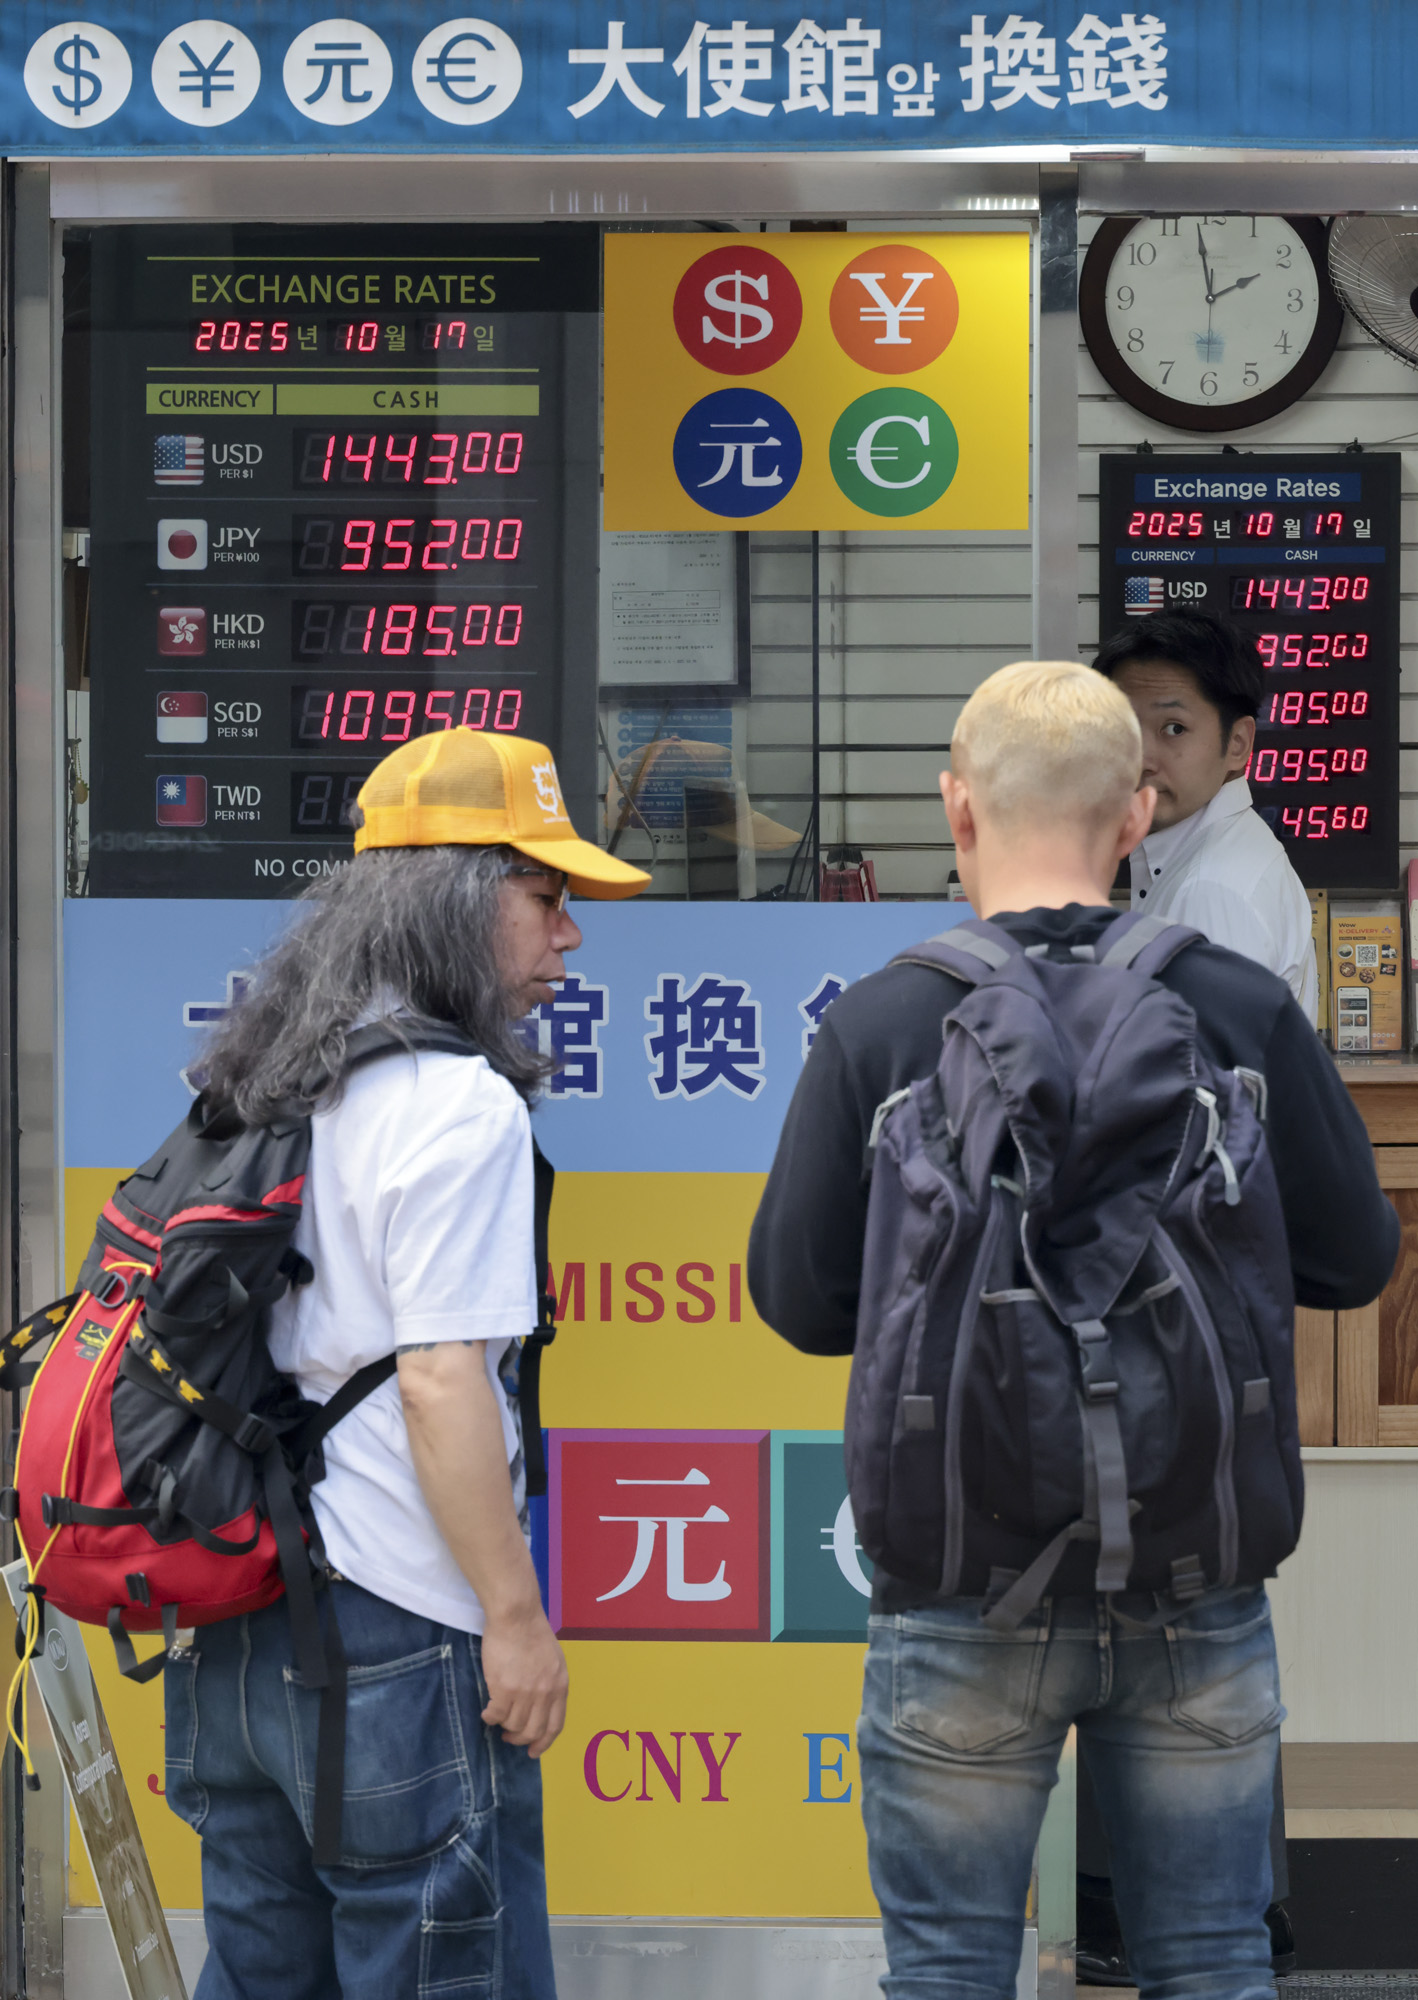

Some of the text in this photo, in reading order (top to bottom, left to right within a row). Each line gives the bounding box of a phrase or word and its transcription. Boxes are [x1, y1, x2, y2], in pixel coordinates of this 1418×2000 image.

[51, 34, 103, 116] $
[303, 42, 373, 105] 元
[958, 14, 1169, 112] 換錢
[1127, 242, 1157, 266] 10
[1276, 244, 1292, 269] 2
[191, 273, 497, 304] EXCHANGE RATES
[1116, 285, 1135, 311] 9
[1286, 288, 1304, 313] 3
[701, 269, 775, 350] $
[848, 272, 935, 345] ¥
[1126, 327, 1145, 353] 8
[1273, 329, 1293, 355] 4
[1158, 360, 1176, 385] 7
[1199, 371, 1218, 397] 6
[1242, 361, 1260, 387] 5
[157, 389, 261, 409] CURRENCY
[372, 390, 440, 409] CASH
[211, 443, 264, 466] USD
[696, 417, 784, 488] 元
[846, 414, 933, 490] €
[219, 468, 240, 480] PER
[1154, 478, 1341, 501] Exchange Rates
[212, 527, 262, 549] JPY
[1131, 550, 1196, 562] CURRENCY
[1284, 550, 1318, 561] CASH
[1168, 581, 1208, 599] USD
[212, 613, 266, 637] HKD
[214, 637, 236, 650] PER
[213, 701, 262, 724] SGD
[217, 727, 239, 738] PER
[212, 785, 262, 807] TWD
[214, 810, 236, 821] PER
[254, 858, 285, 877] NO
[595, 1467, 733, 1603] 元
[583, 1729, 743, 1804] CNY
